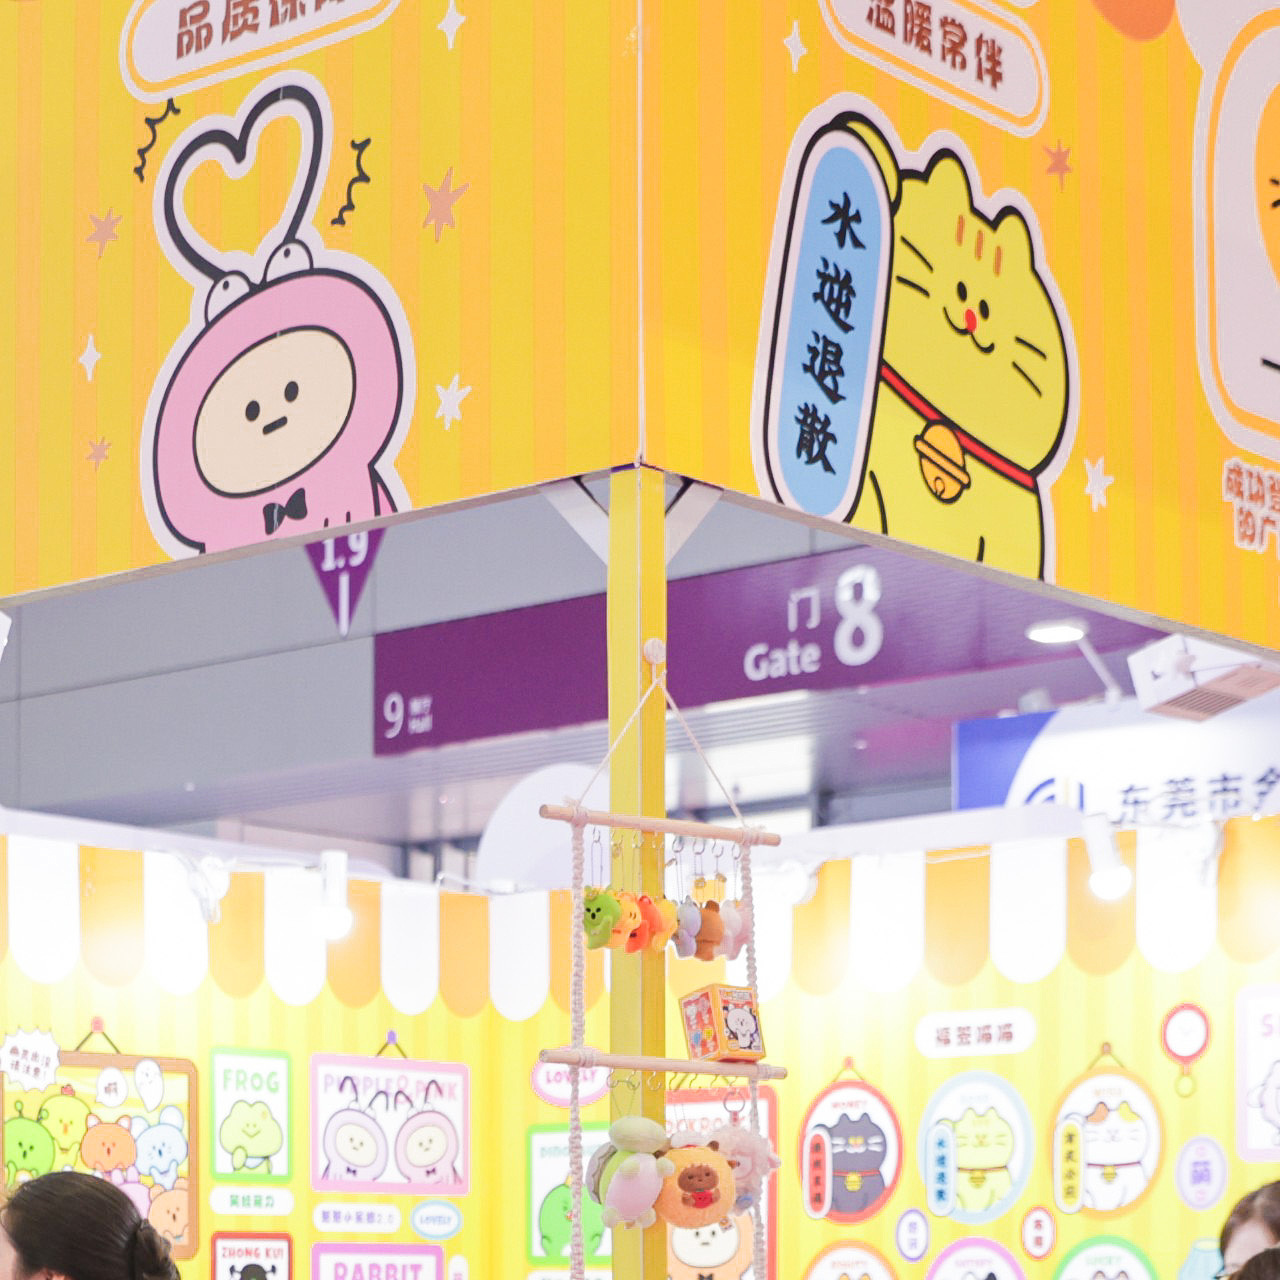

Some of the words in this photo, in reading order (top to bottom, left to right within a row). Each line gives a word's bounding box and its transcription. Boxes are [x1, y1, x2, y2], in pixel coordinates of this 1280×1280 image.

[865, 0, 1004, 90] 温暖常伴
[794, 192, 866, 475] 水逆退散
[744, 637, 821, 682] Gate
[833, 563, 883, 667] 8
[223, 1068, 280, 1094] FROG
[545, 1070, 597, 1085] LOVLY
